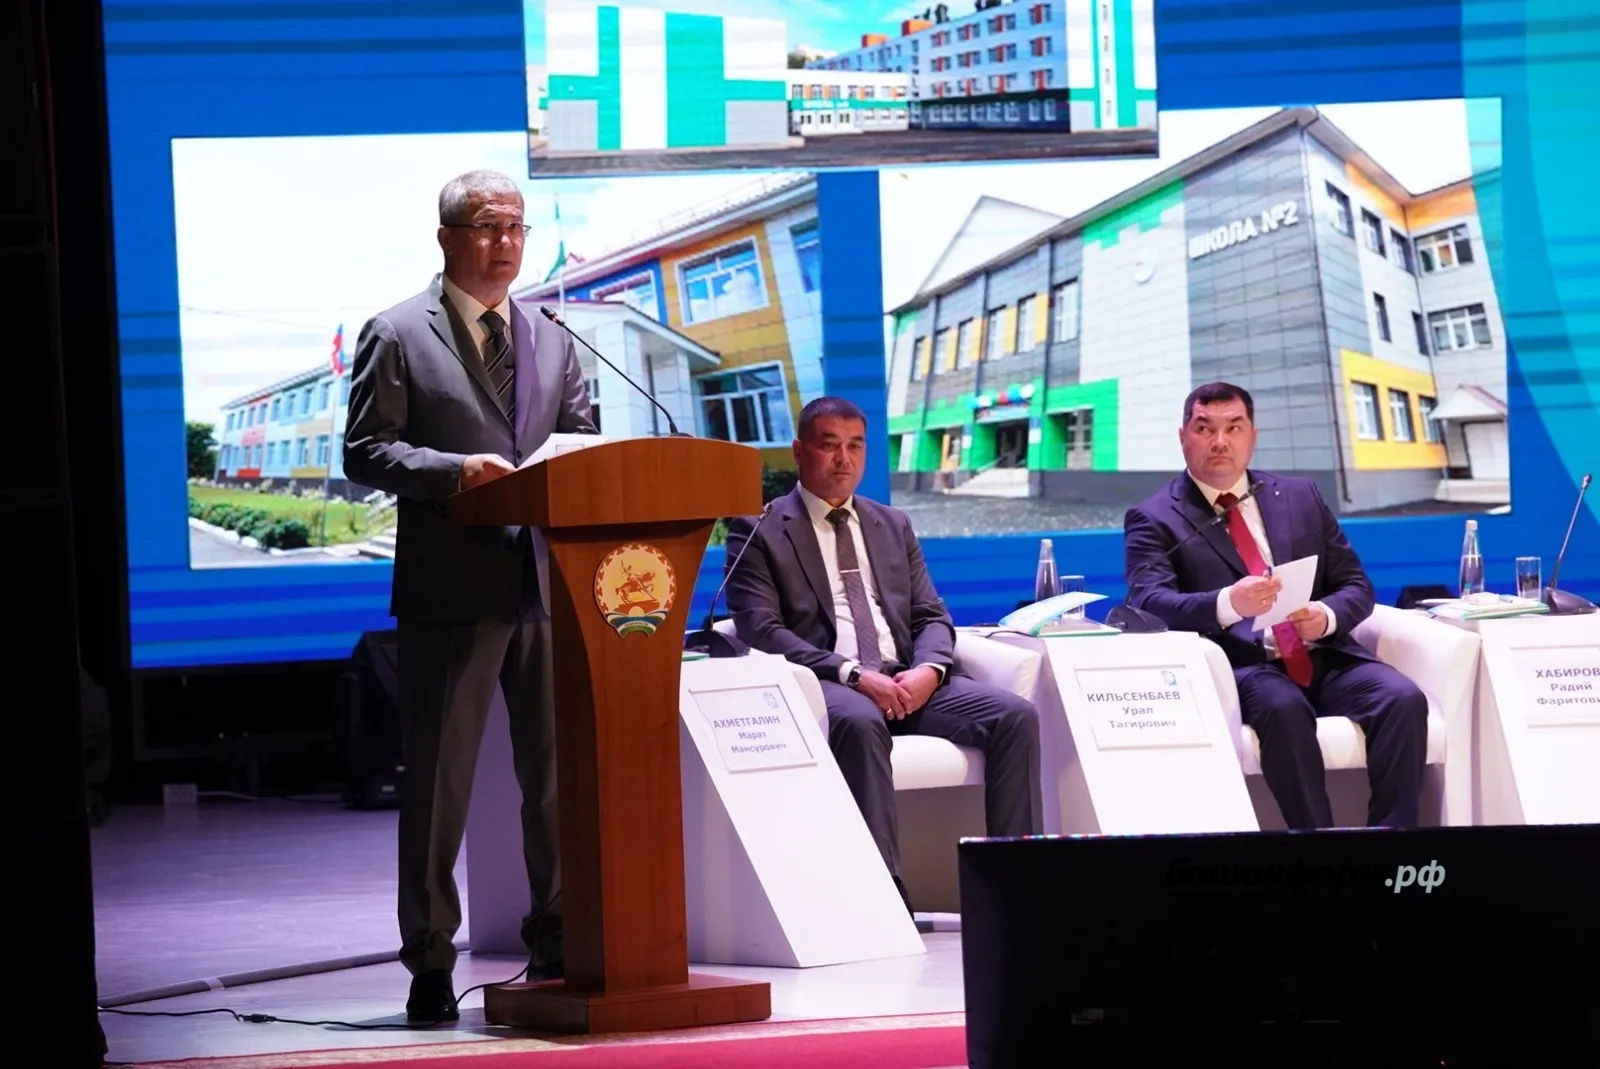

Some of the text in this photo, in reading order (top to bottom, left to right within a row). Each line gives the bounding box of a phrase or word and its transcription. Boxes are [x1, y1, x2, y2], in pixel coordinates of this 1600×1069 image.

[1188, 200, 1299, 260] ШКОЛА №2
[1535, 667, 1600, 678] ХАБИРОВ
[1550, 681, 1593, 692] Радий
[1087, 691, 1181, 702] КИЛЬСЕНБАЕВ
[1122, 706, 1154, 716] Урал
[713, 716, 781, 728] АХМЕТГАЛИН
[1108, 720, 1177, 729] Тагирович
[738, 731, 767, 740] Марат
[731, 743, 787, 753] Мансурович
